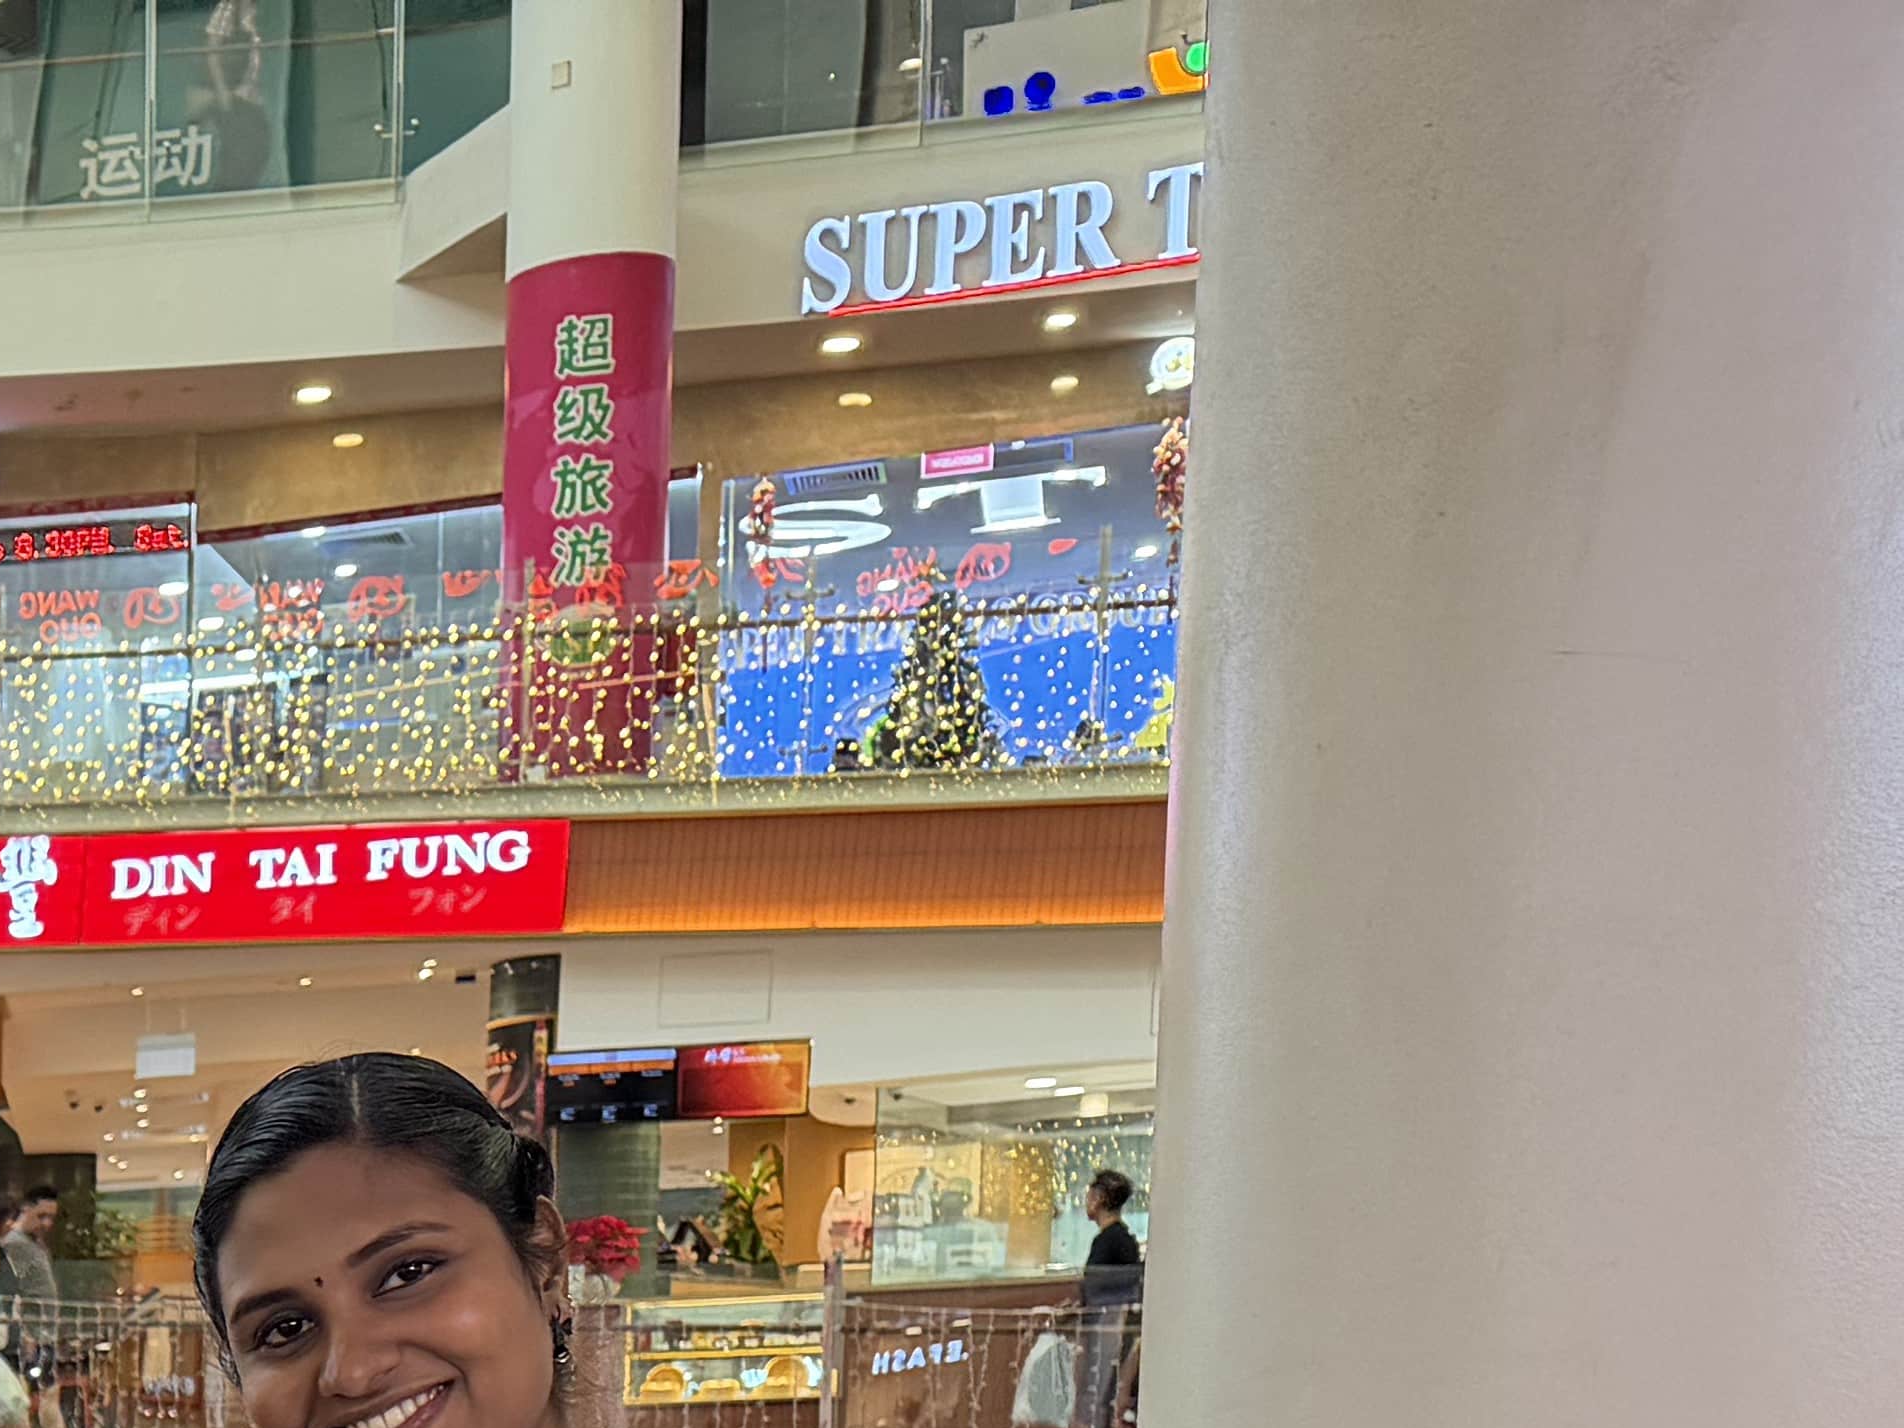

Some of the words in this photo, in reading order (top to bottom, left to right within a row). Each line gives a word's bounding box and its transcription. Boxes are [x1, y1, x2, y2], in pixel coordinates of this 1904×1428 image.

[80, 124, 212, 199] 运动
[803, 178, 1118, 315] SUPER
[553, 313, 615, 587] 超级旅游
[110, 851, 214, 902] DIN
[249, 843, 338, 891] TAI
[365, 829, 532, 881] FUNG
